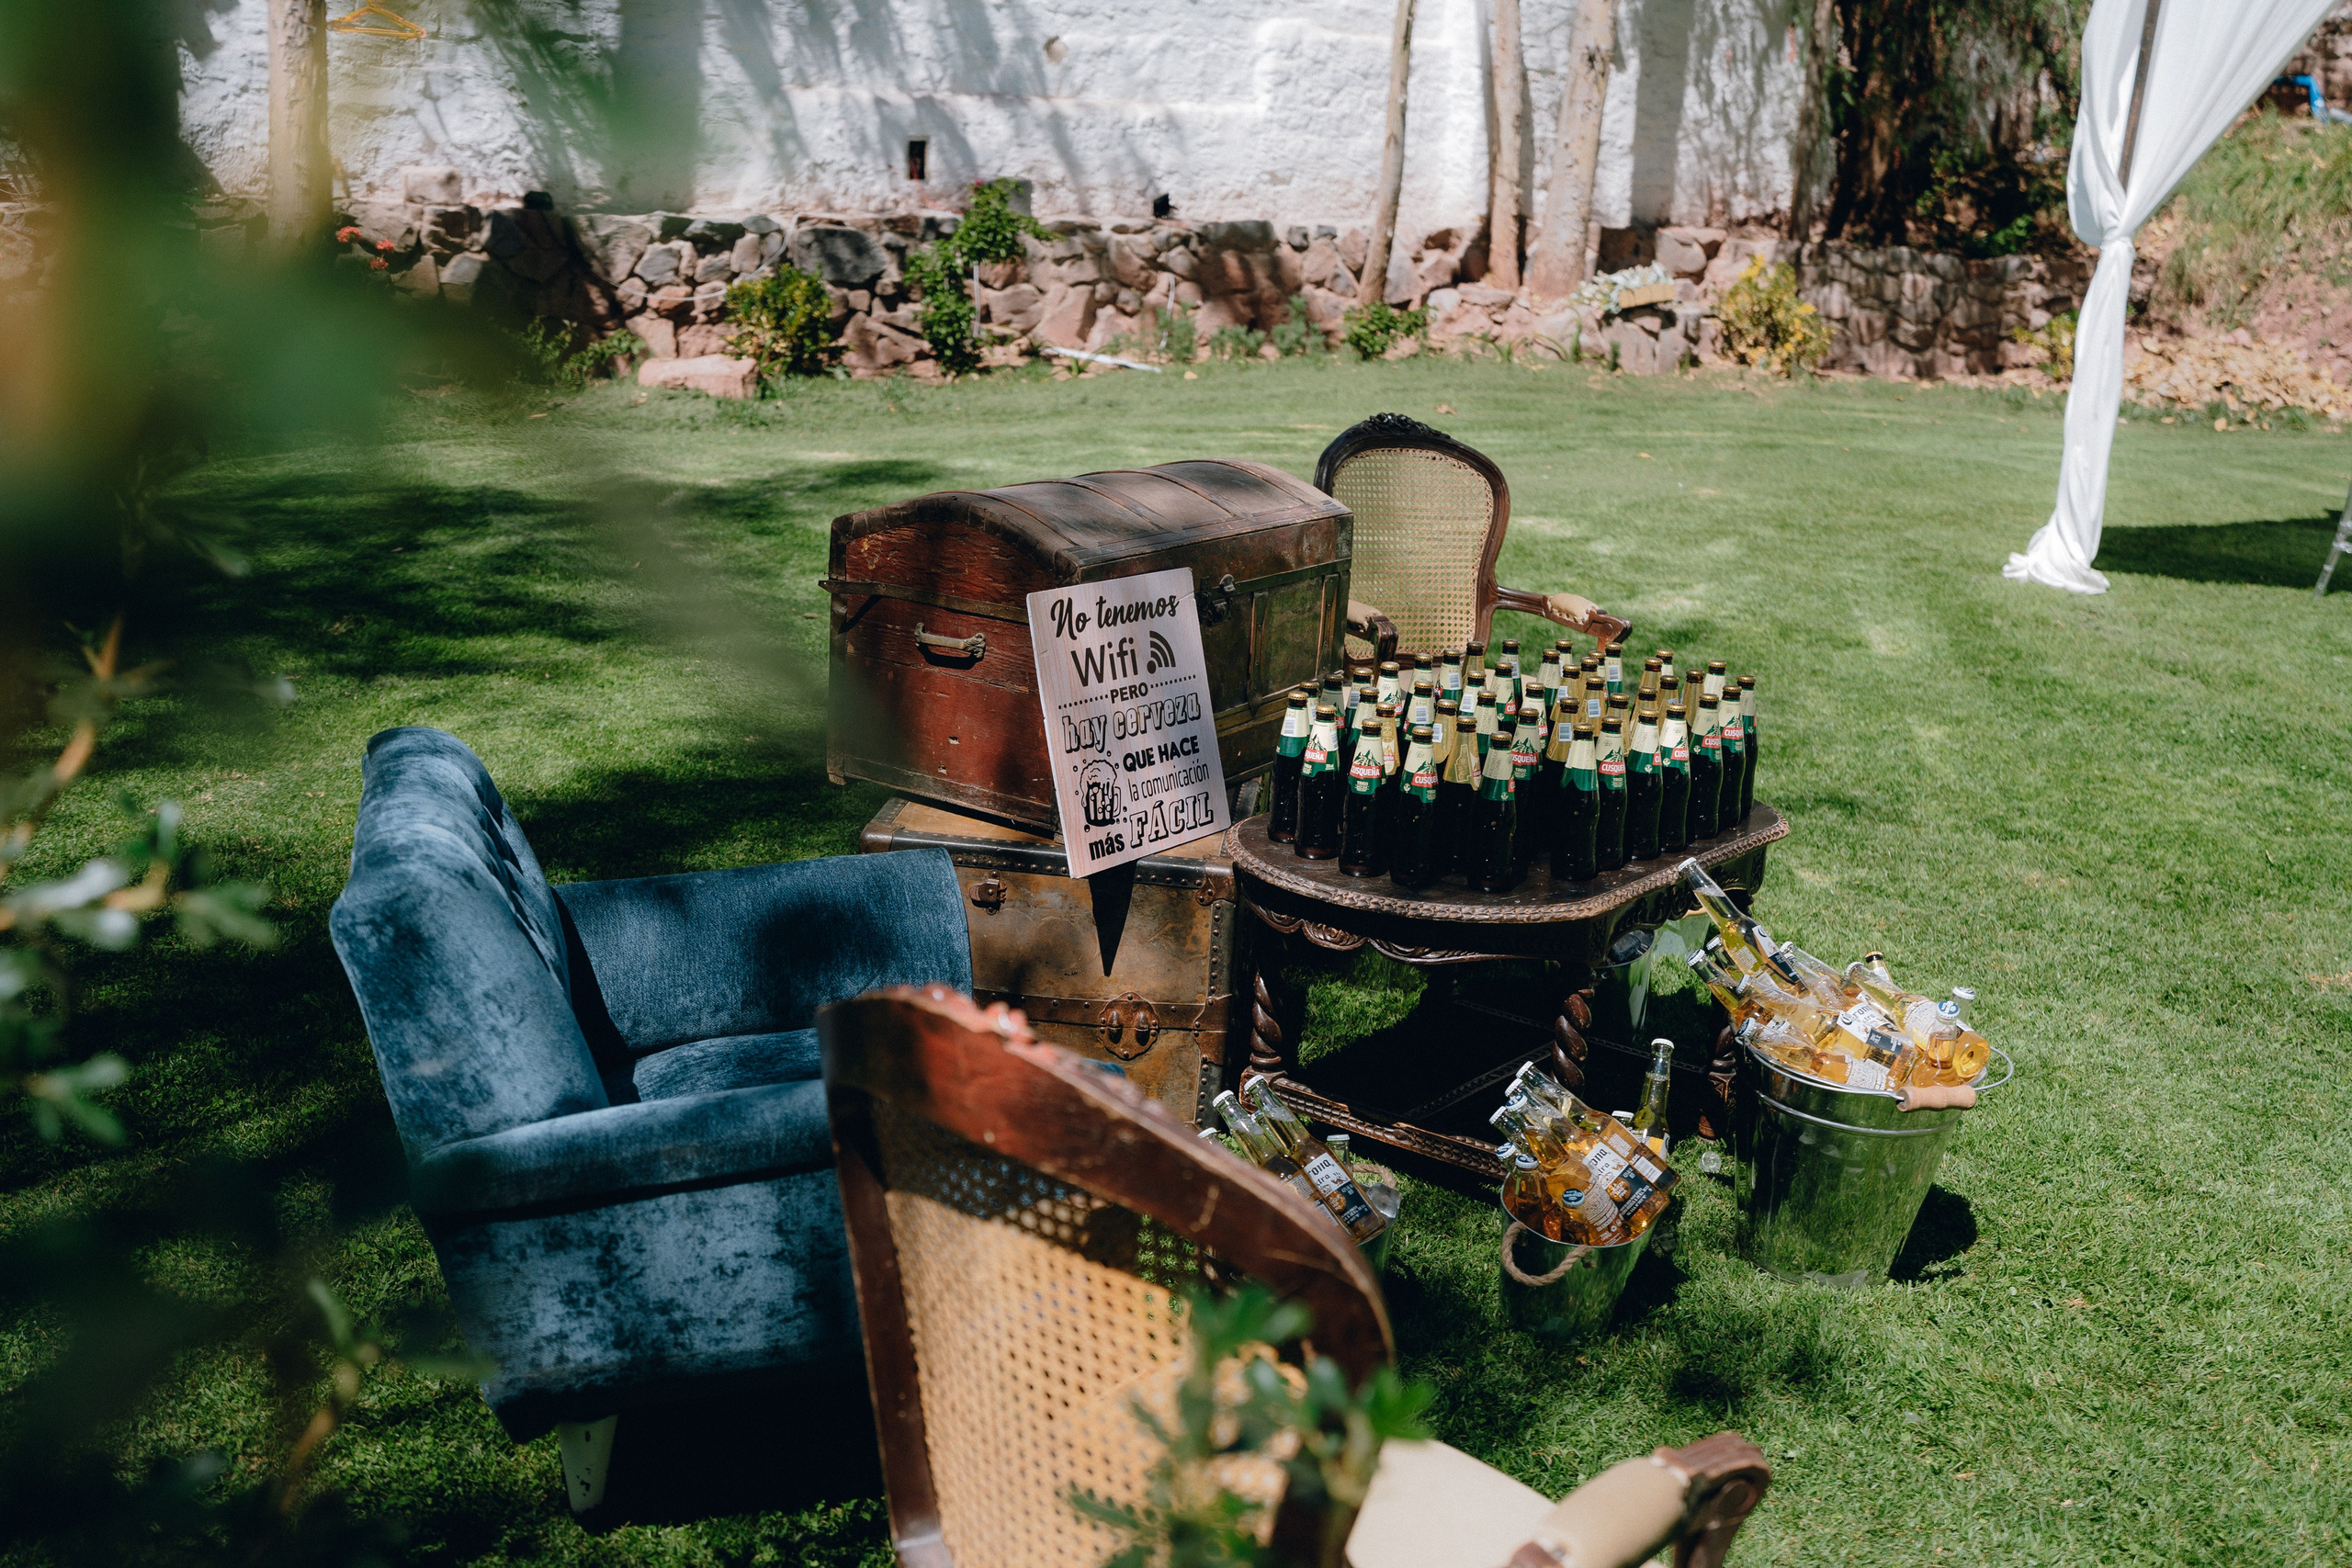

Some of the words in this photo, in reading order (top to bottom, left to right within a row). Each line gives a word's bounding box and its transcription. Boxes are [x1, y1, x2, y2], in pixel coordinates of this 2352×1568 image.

[1050, 596, 1091, 640] No
[1097, 594, 1179, 628] tenemos
[1070, 637, 1138, 687] Wifi
[1110, 682, 1148, 704] PERO
[1062, 708, 1107, 753] hay
[1113, 693, 1201, 740] cerveza
[1123, 748, 1156, 773] QUE
[1159, 736, 1200, 762] HACE
[1128, 779, 1139, 802] la
[1141, 761, 1210, 799] comunicación
[1089, 831, 1125, 862] más
[1129, 791, 1215, 849] FÁCIL
